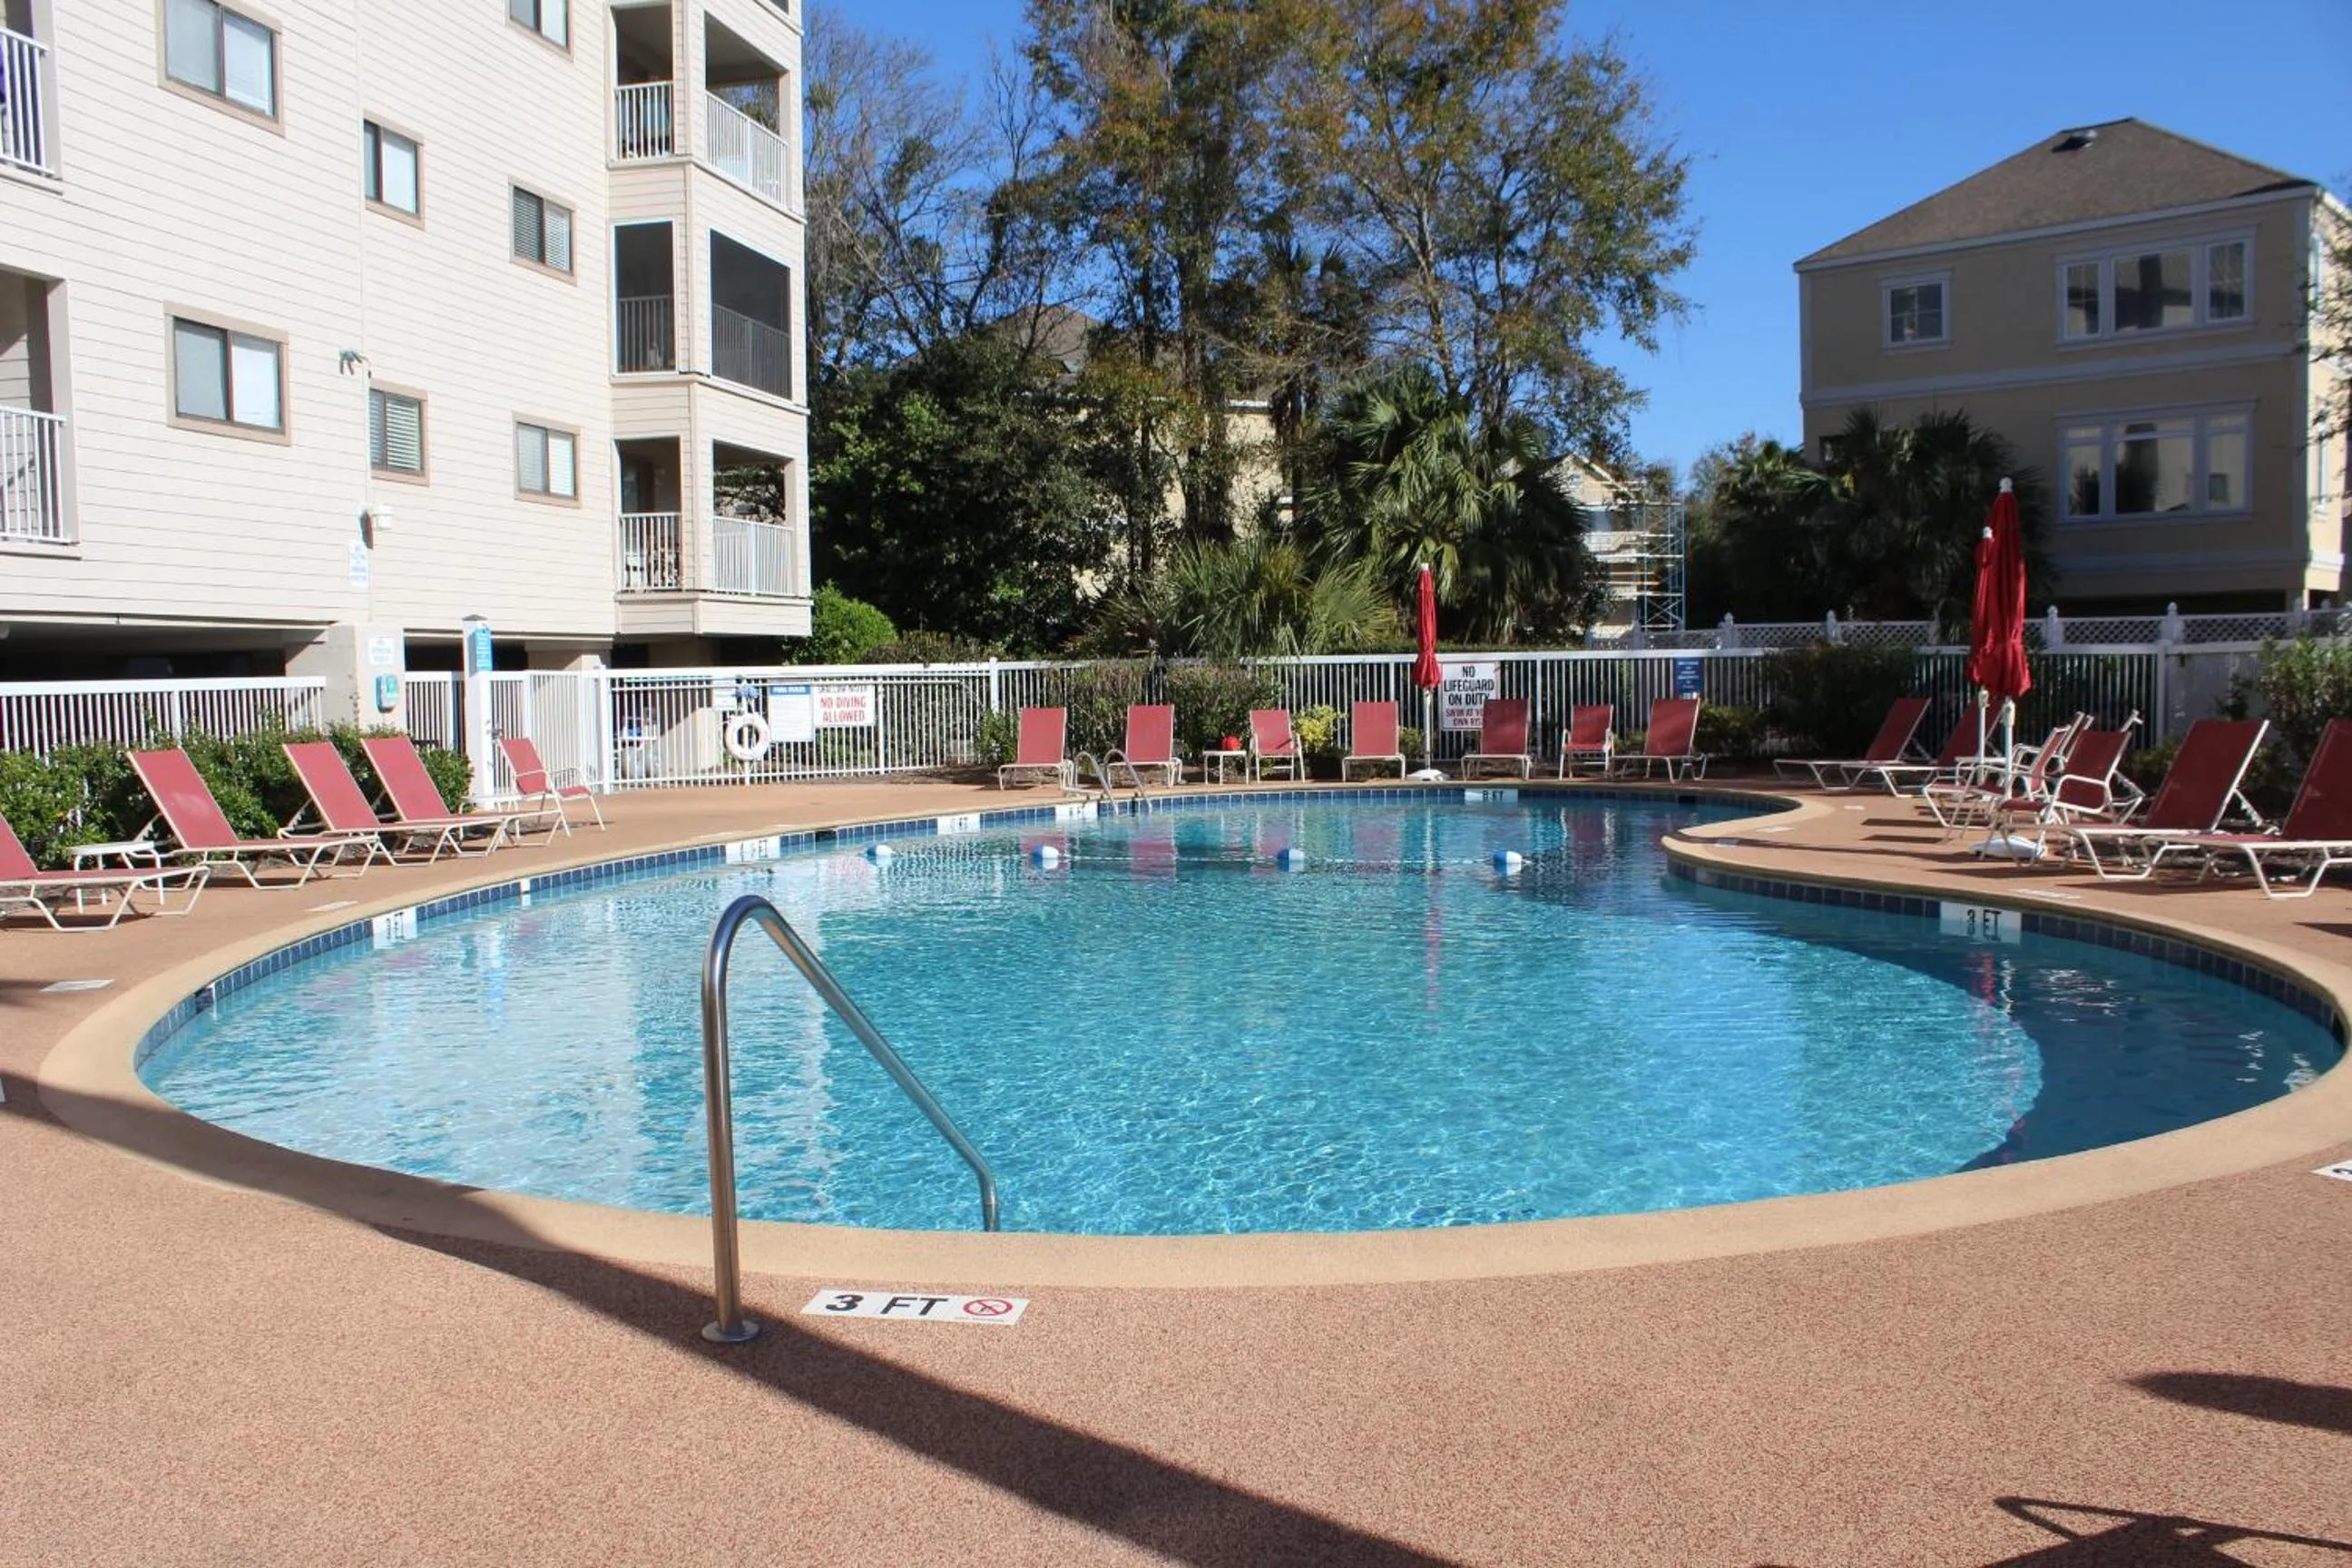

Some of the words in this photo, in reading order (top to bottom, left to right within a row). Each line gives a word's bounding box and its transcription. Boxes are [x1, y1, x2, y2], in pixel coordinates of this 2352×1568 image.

[1462, 665, 1476, 678] NO
[1444, 678, 1495, 692] LIFEGUARD
[820, 696, 833, 708] NO
[835, 696, 867, 708] DIVING
[1448, 692, 1463, 705] ON
[822, 710, 865, 723] ALLOWED
[826, 1294, 864, 1311] 3
[880, 1296, 948, 1316] FT
